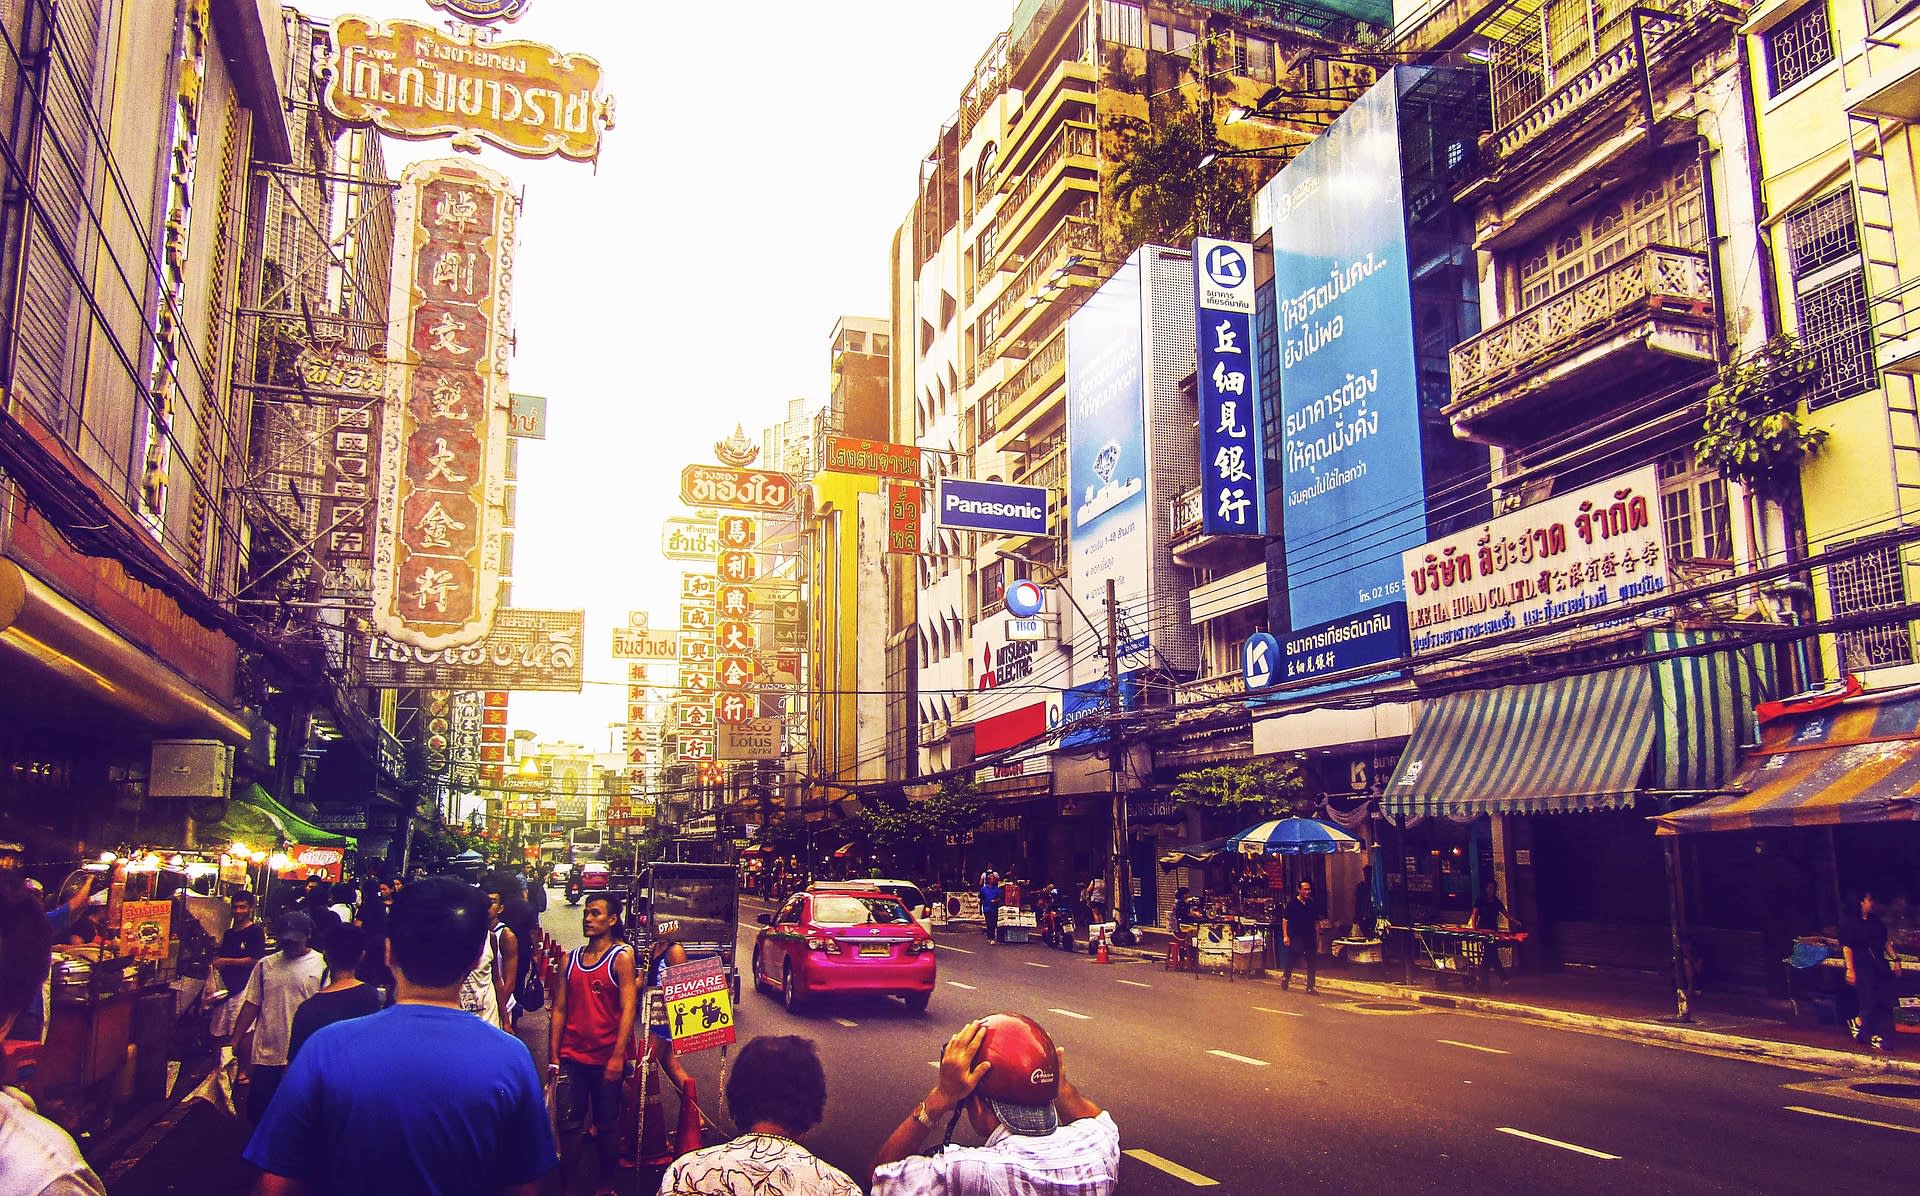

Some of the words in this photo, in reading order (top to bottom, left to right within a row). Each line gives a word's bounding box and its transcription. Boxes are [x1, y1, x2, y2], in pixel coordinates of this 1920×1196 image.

[414, 35, 527, 74] ห้างขายทอง
[342, 46, 591, 133] โต๊ะกังเยาวราช
[1206, 289, 1235, 299] ธนาคาร
[1284, 315, 1344, 369] ยังไม่พอ
[1286, 368, 1378, 438] ธนาคารต้อง
[1212, 319, 1252, 526] 丘細見銀行
[1286, 400, 1378, 474] ให้คุณมั่งคั่ง
[827, 441, 919, 476] โรงรับจำนำ
[691, 474, 786, 506] ทองใบ
[1288, 460, 1367, 508] เงินคุณไปได้ไกลกว่า
[945, 494, 1042, 520] Panasonic
[891, 524, 916, 549] หลี
[1410, 545, 1472, 596] บริษัท
[1574, 487, 1649, 545] จำกัด
[1372, 586, 1383, 600] 02
[1385, 582, 1400, 597] 165
[722, 519, 747, 721] 馬利興大金行
[1016, 620, 1037, 631] TISCO
[1410, 607, 1433, 630] LEE
[1433, 601, 1451, 624] HA
[1452, 592, 1487, 619] HUAD
[1286, 612, 1391, 656] ธนาคารเกียรตินาคิน
[685, 574, 710, 759] 和成興大金行
[996, 641, 1038, 667] MITSUBISHI
[996, 656, 1033, 686] ELECTRIC
[729, 735, 772, 748] Lotus
[608, 808, 620, 819] 24
[664, 974, 724, 996] BEWARE
[665, 993, 675, 1002] OF
